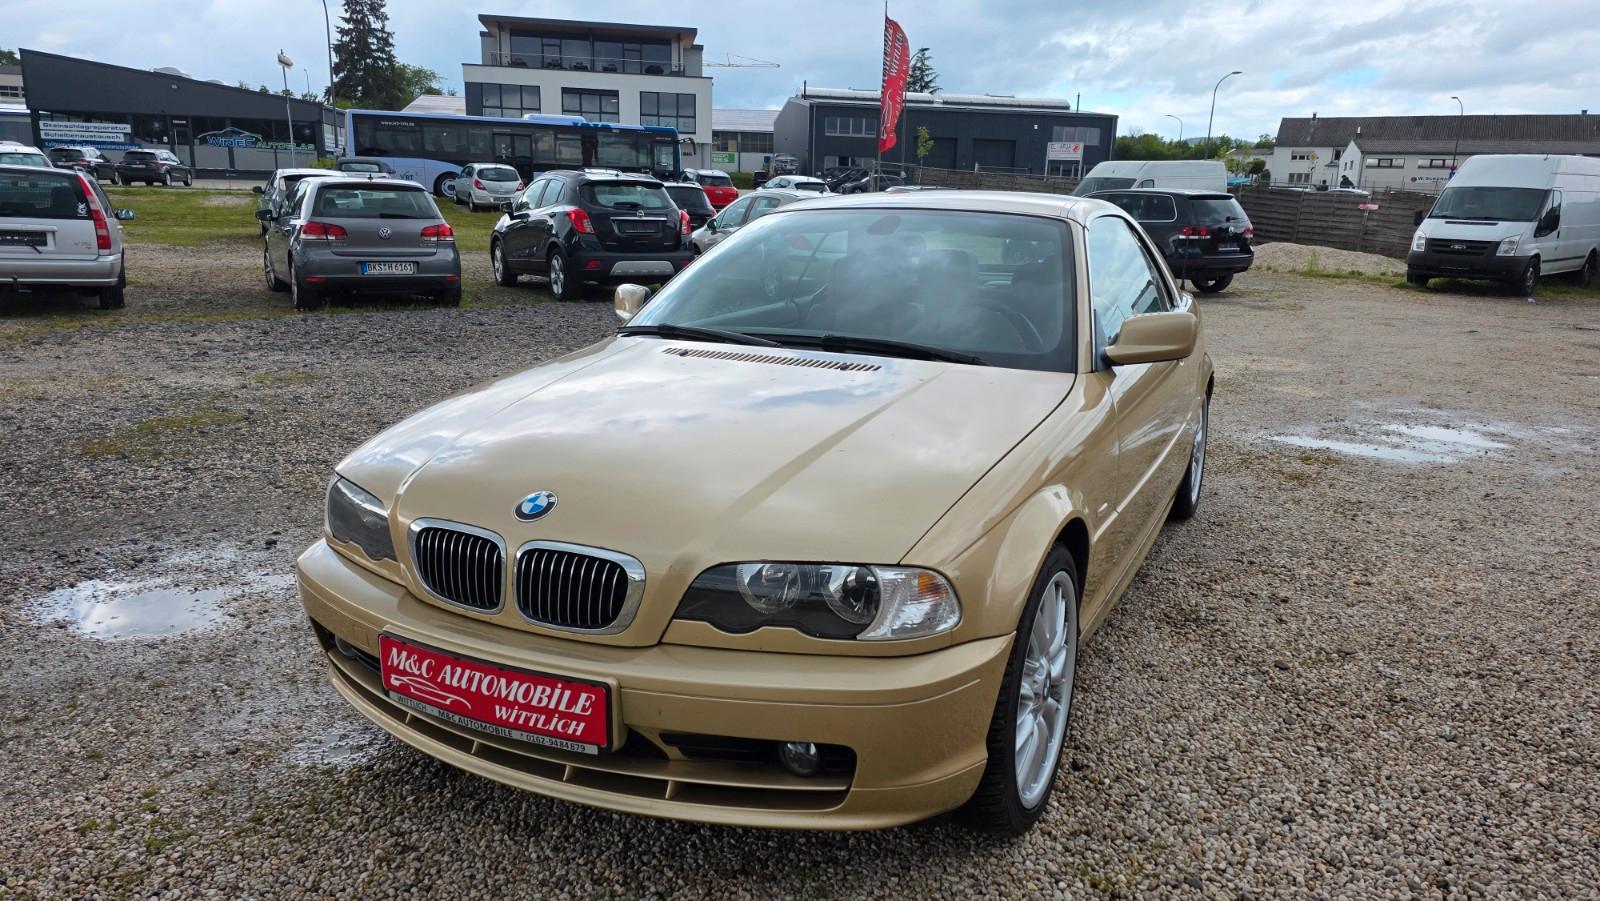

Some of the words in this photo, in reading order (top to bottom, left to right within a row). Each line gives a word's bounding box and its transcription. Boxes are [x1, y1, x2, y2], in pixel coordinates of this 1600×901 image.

[367, 263, 383, 272] BKS
[387, 263, 394, 272] H
[394, 263, 413, 272] 6161
[387, 646, 436, 678] M&C
[437, 664, 596, 716] AUTOMOBiLE
[457, 717, 513, 738] AUTOMOBILE
[494, 704, 586, 736] WiTTLiCH
